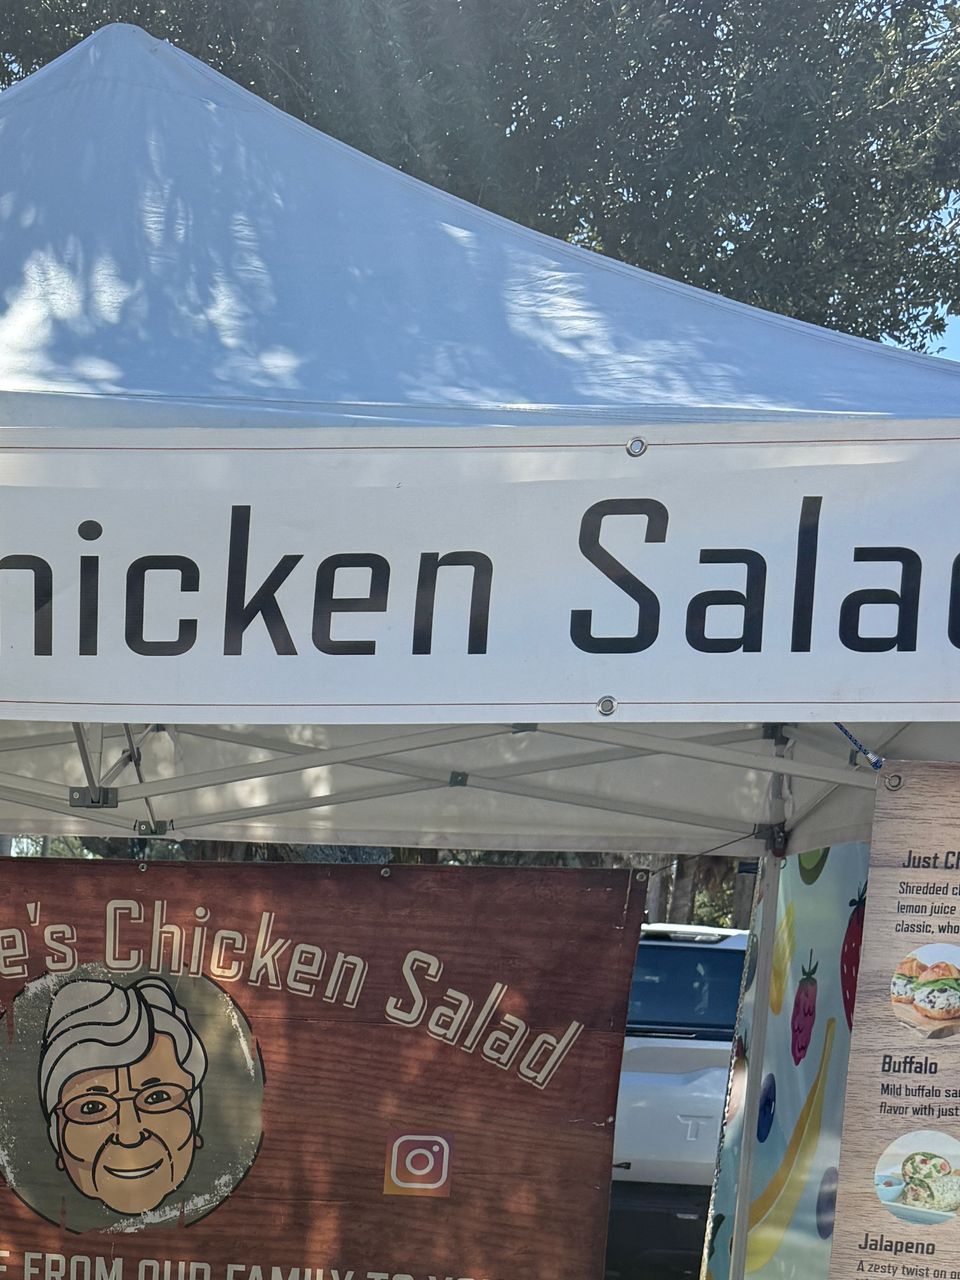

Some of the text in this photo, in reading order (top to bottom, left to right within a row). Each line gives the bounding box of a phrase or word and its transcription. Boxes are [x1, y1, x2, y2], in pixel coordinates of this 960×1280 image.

[570, 496, 960, 655] Sala
[902, 850, 940, 869] Just
[899, 881, 960, 896] Shredded c
[897, 900, 957, 916] lemon juice
[895, 920, 934, 934] classic,
[105, 898, 369, 1009] Chicken
[385, 949, 585, 1089] Salad
[881, 1055, 938, 1074] Buffalo
[881, 1083, 960, 1098] Mild buffalo sa
[880, 1101, 960, 1119] flavor with just
[858, 1233, 935, 1255] Jalapeno
[857, 1260, 865, 1272] A
[867, 1263, 898, 1277] zesty
[901, 1264, 930, 1278] twist
[933, 1269, 946, 1279] on
